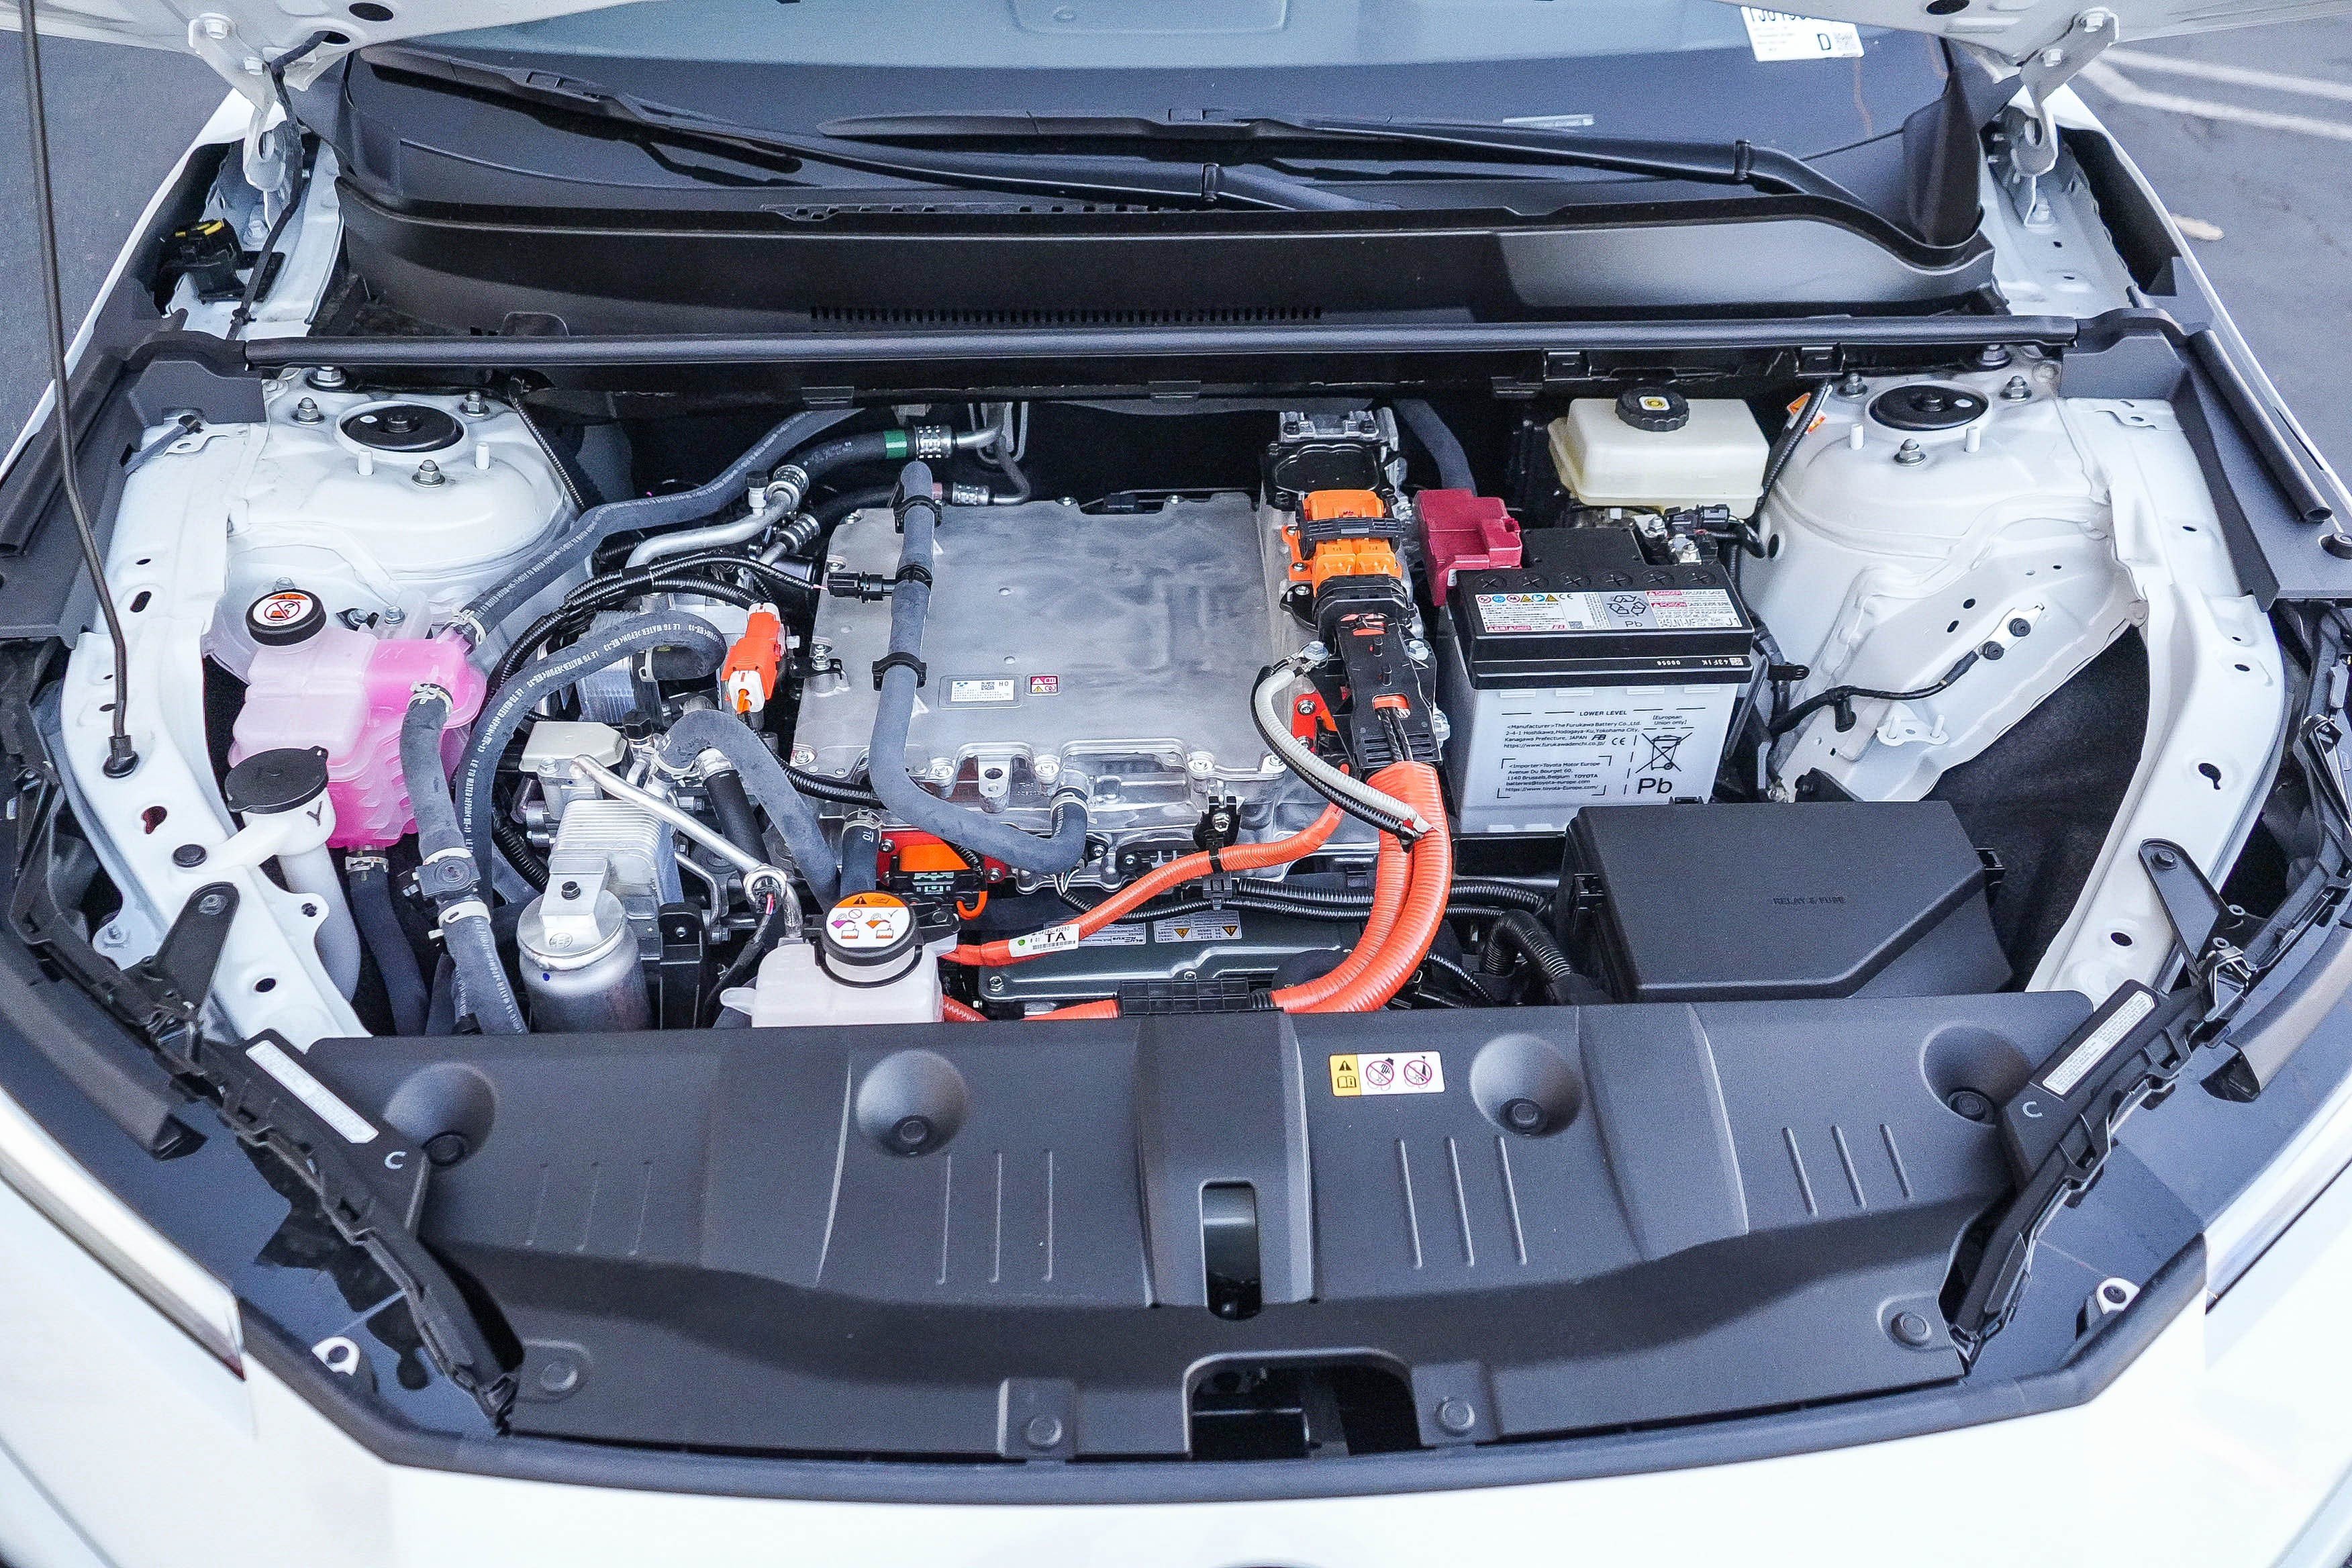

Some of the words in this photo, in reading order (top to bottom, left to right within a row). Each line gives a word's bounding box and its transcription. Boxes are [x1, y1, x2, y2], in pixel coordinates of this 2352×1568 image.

[1817, 34, 1831, 50] D
[1637, 777, 1673, 795] Pb
[1044, 932, 1066, 943] TA
